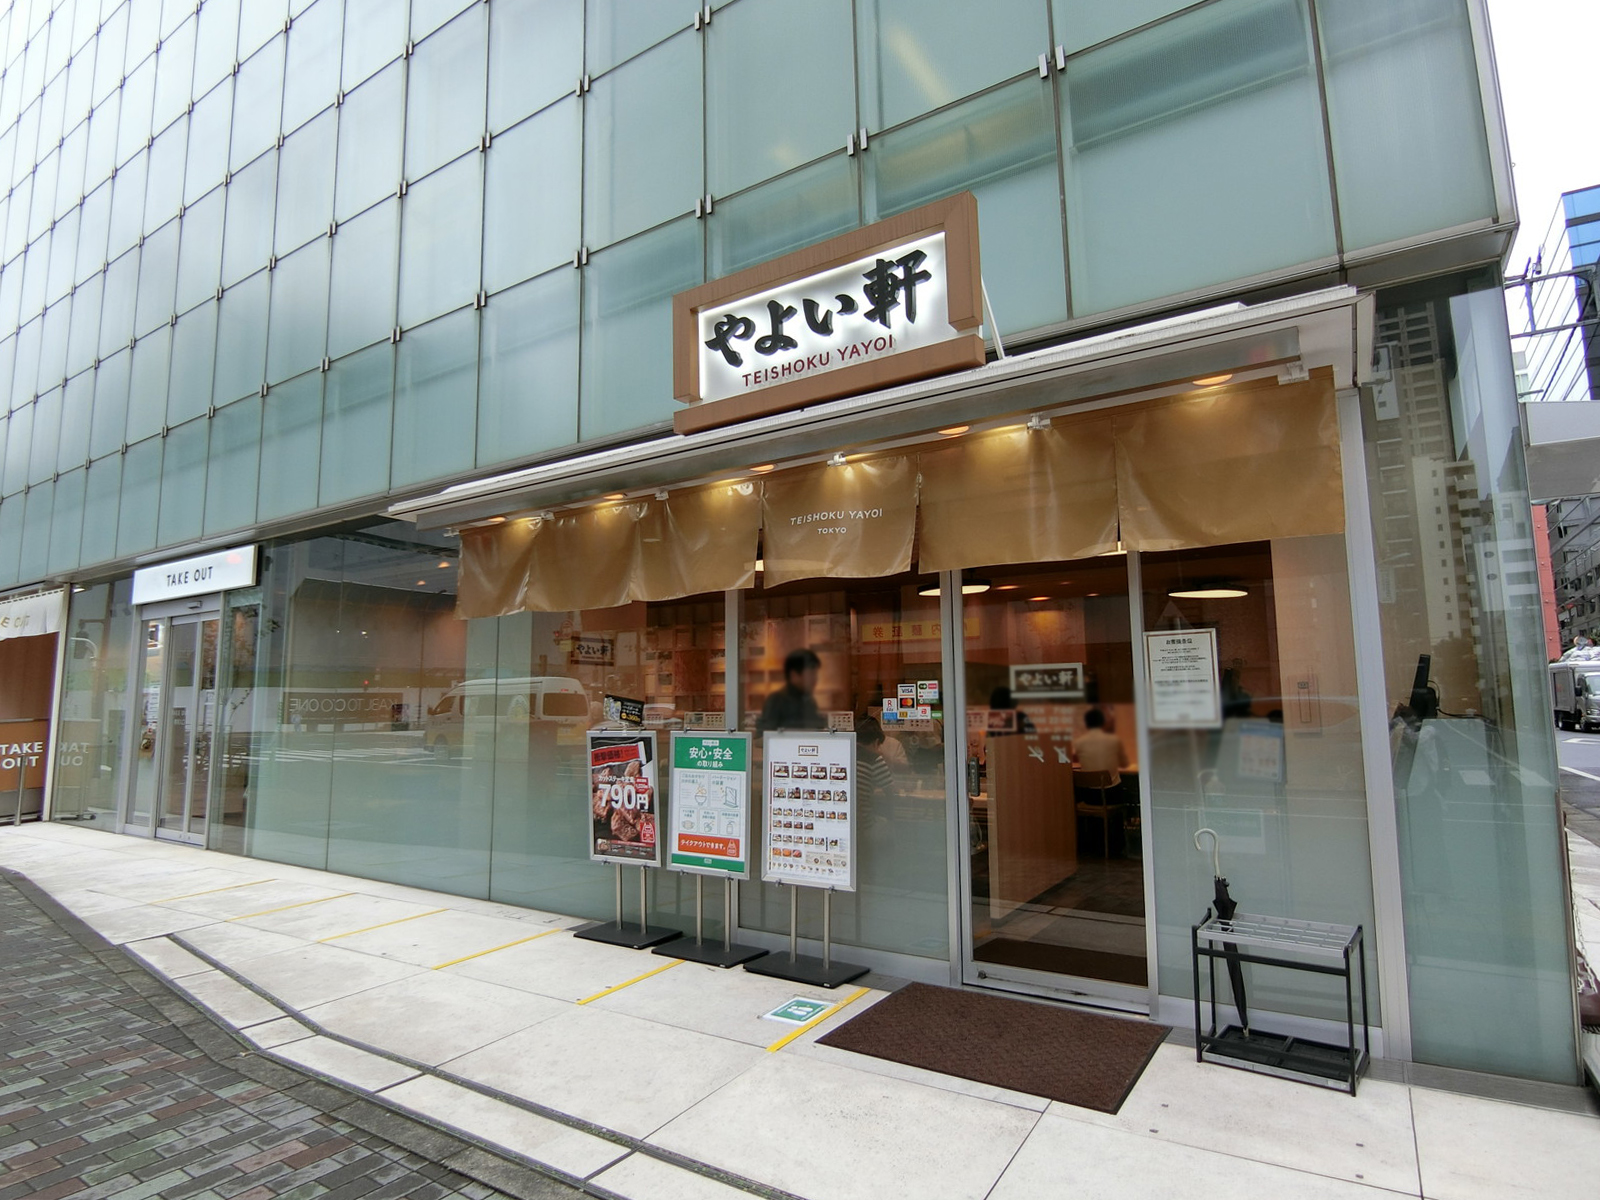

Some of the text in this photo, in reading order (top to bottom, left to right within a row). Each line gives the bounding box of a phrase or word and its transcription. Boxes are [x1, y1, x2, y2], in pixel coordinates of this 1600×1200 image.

[704, 249, 932, 368] やよい軒
[742, 334, 894, 387] TEISHOKU YAYOI
[790, 508, 883, 526] TEISHOKU YAYOI
[817, 526, 847, 535] TOKYO
[167, 566, 213, 587] TAKE OUT
[1018, 670, 1073, 686] やよい軒
[0, 741, 43, 755] TAKE
[689, 747, 733, 760] 安心・安全
[697, 760, 723, 768] の取り組み
[598, 783, 649, 810] 790円
